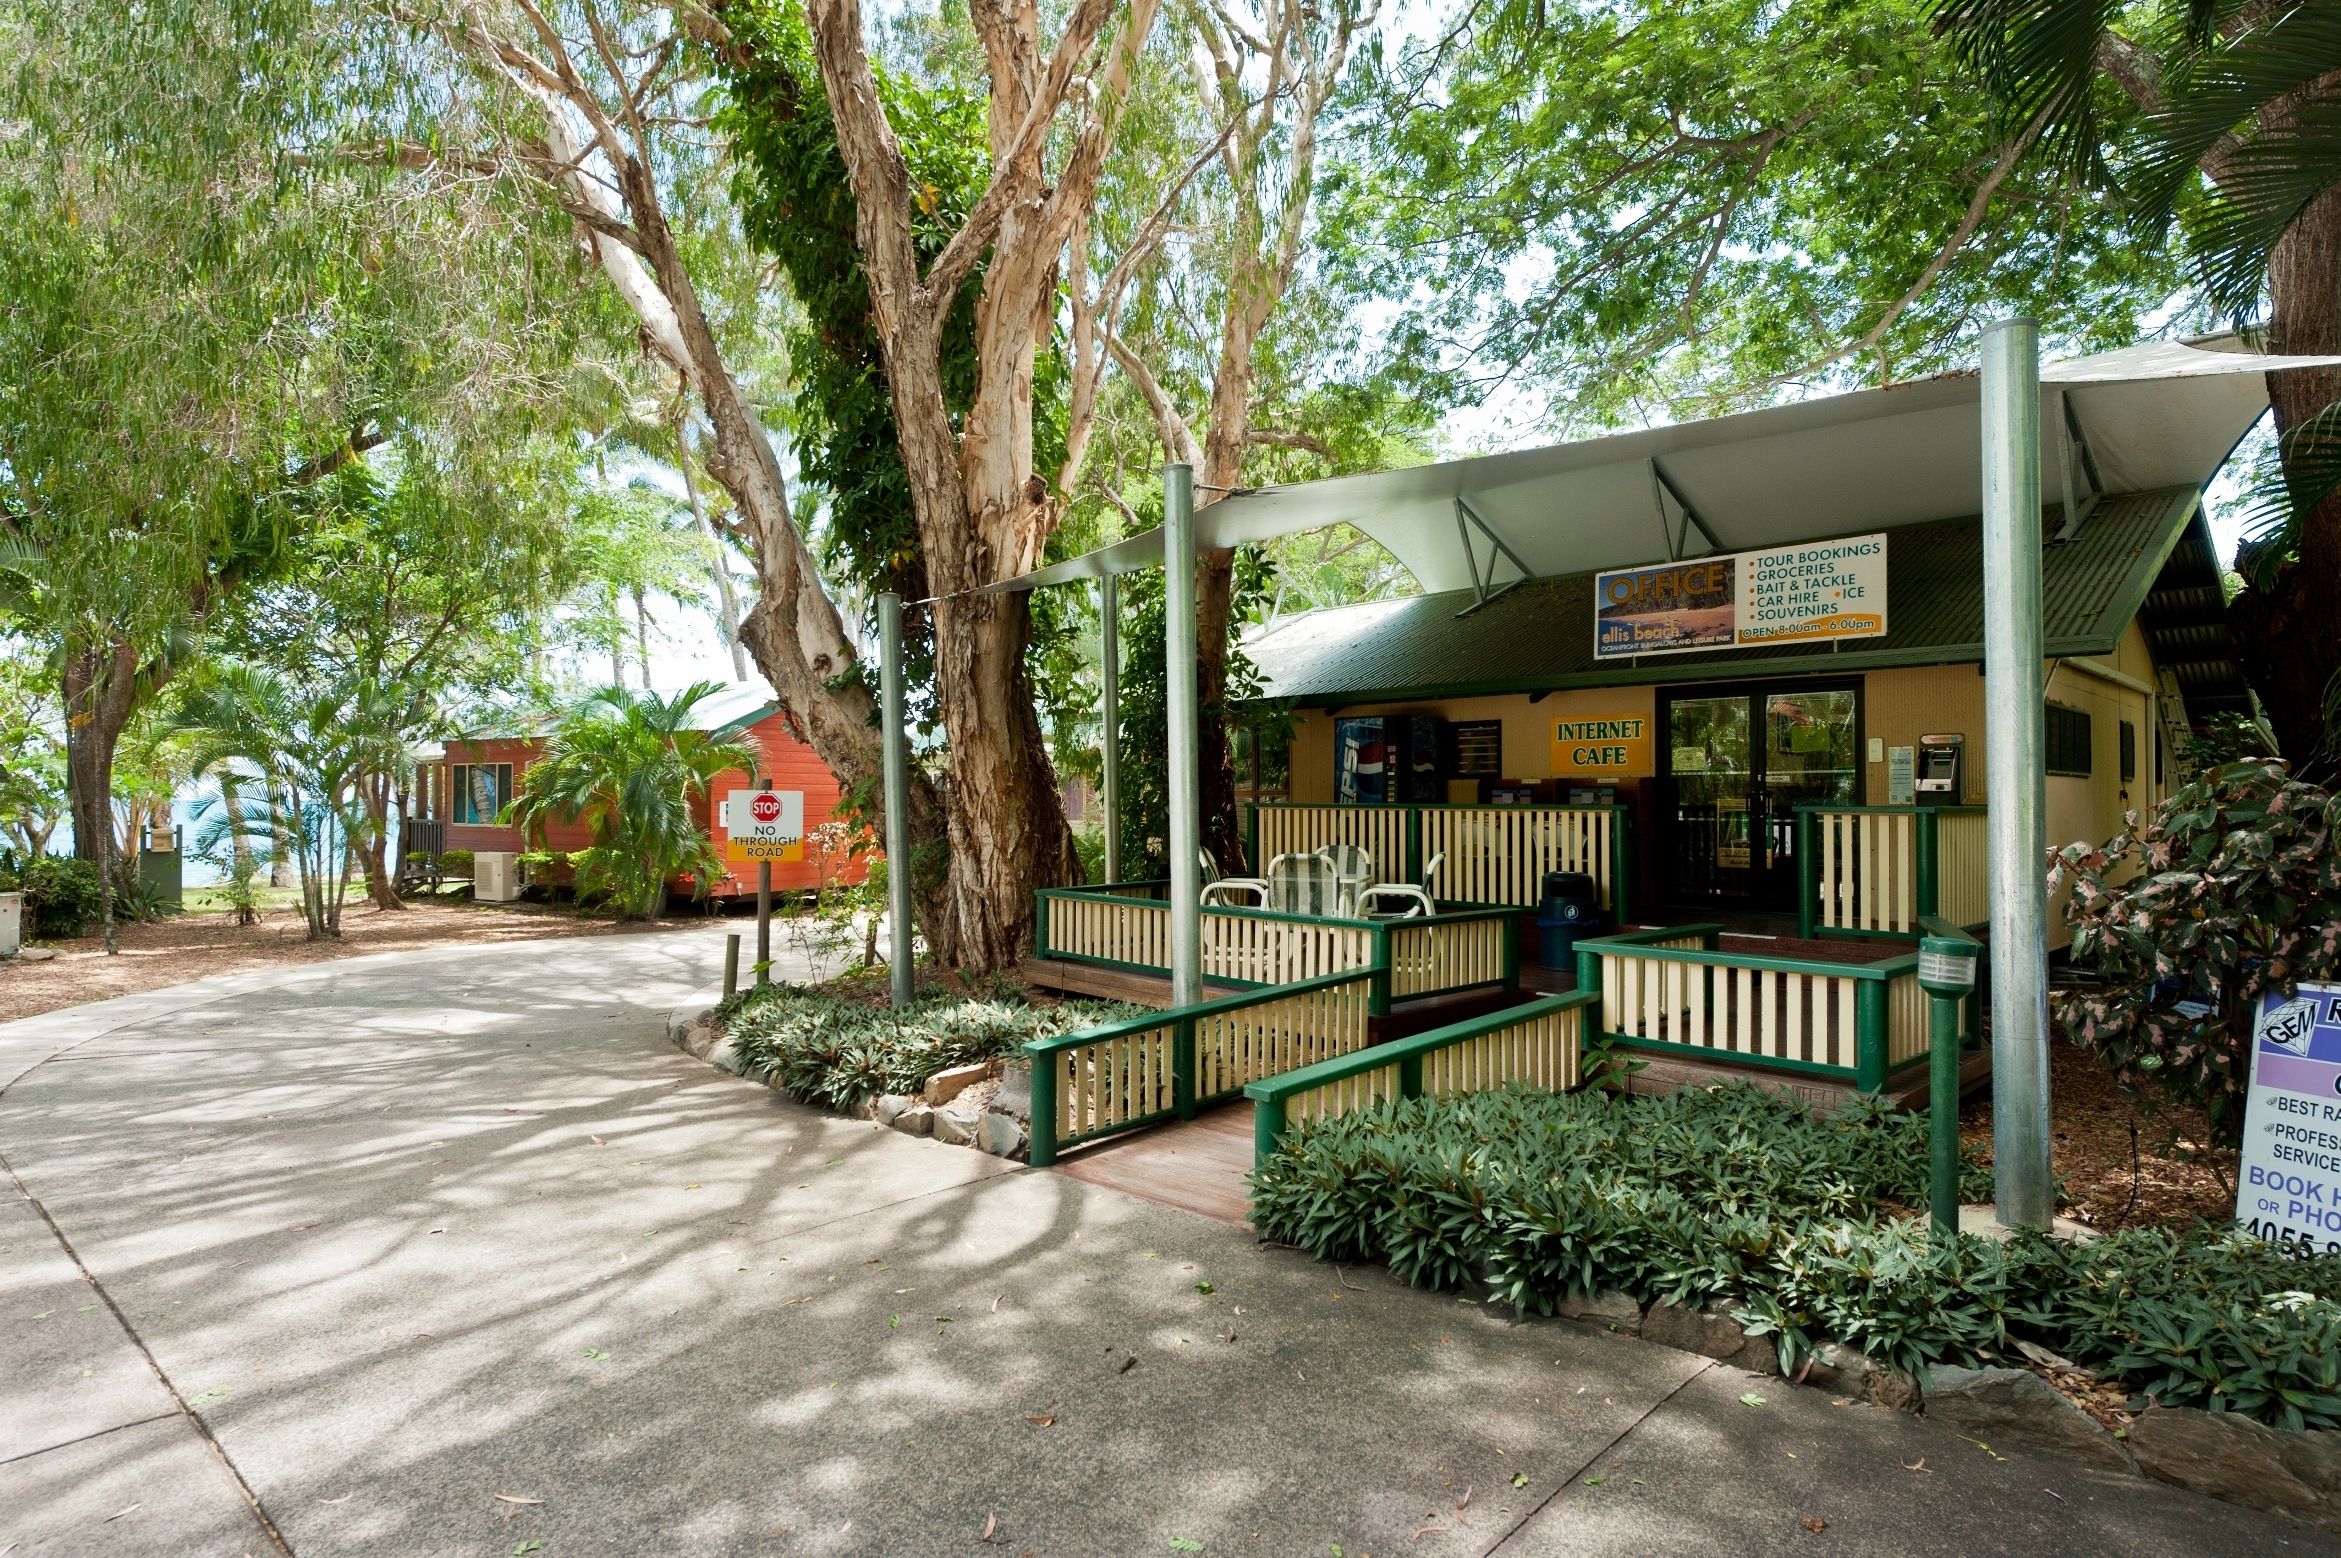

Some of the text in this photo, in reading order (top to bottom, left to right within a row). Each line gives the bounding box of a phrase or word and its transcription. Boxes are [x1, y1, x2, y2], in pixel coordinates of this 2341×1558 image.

[1757, 543, 1880, 569] TOUR BOOKINGS
[1757, 562, 1835, 582] GROCERIES
[1607, 563, 1725, 606] OFFICE
[1757, 573, 1856, 595] BAIT & TACKLE
[1843, 586, 1865, 599] ICE
[1757, 591, 1820, 608] CAR HIRE
[1757, 602, 1839, 621] SOUVENIRS
[1602, 622, 1680, 643] ellis beach
[1742, 626, 1775, 638] OPEN
[1778, 623, 1821, 635] 8:00am
[1601, 642, 1640, 653] OCEANFRONT
[1640, 639, 1678, 649] BUNGALOWS
[1678, 638, 1692, 646] AND
[1716, 634, 1732, 642] PARK
[1557, 719, 1644, 741] INTERNET
[1571, 746, 1628, 766] CAFE
[753, 801, 780, 814] STOP
[755, 826, 775, 835] NO
[734, 836, 797, 846] THROUGH
[747, 847, 784, 857] ROAD
[2266, 1003, 2316, 1043] GEM
[2278, 1096, 2319, 1117] BEST
[2323, 1105, 2341, 1121] RA
[2275, 1123, 2341, 1150] PROFES
[2249, 1165, 2324, 1203] BOOK
[2257, 1198, 2341, 1232] OR PHO
